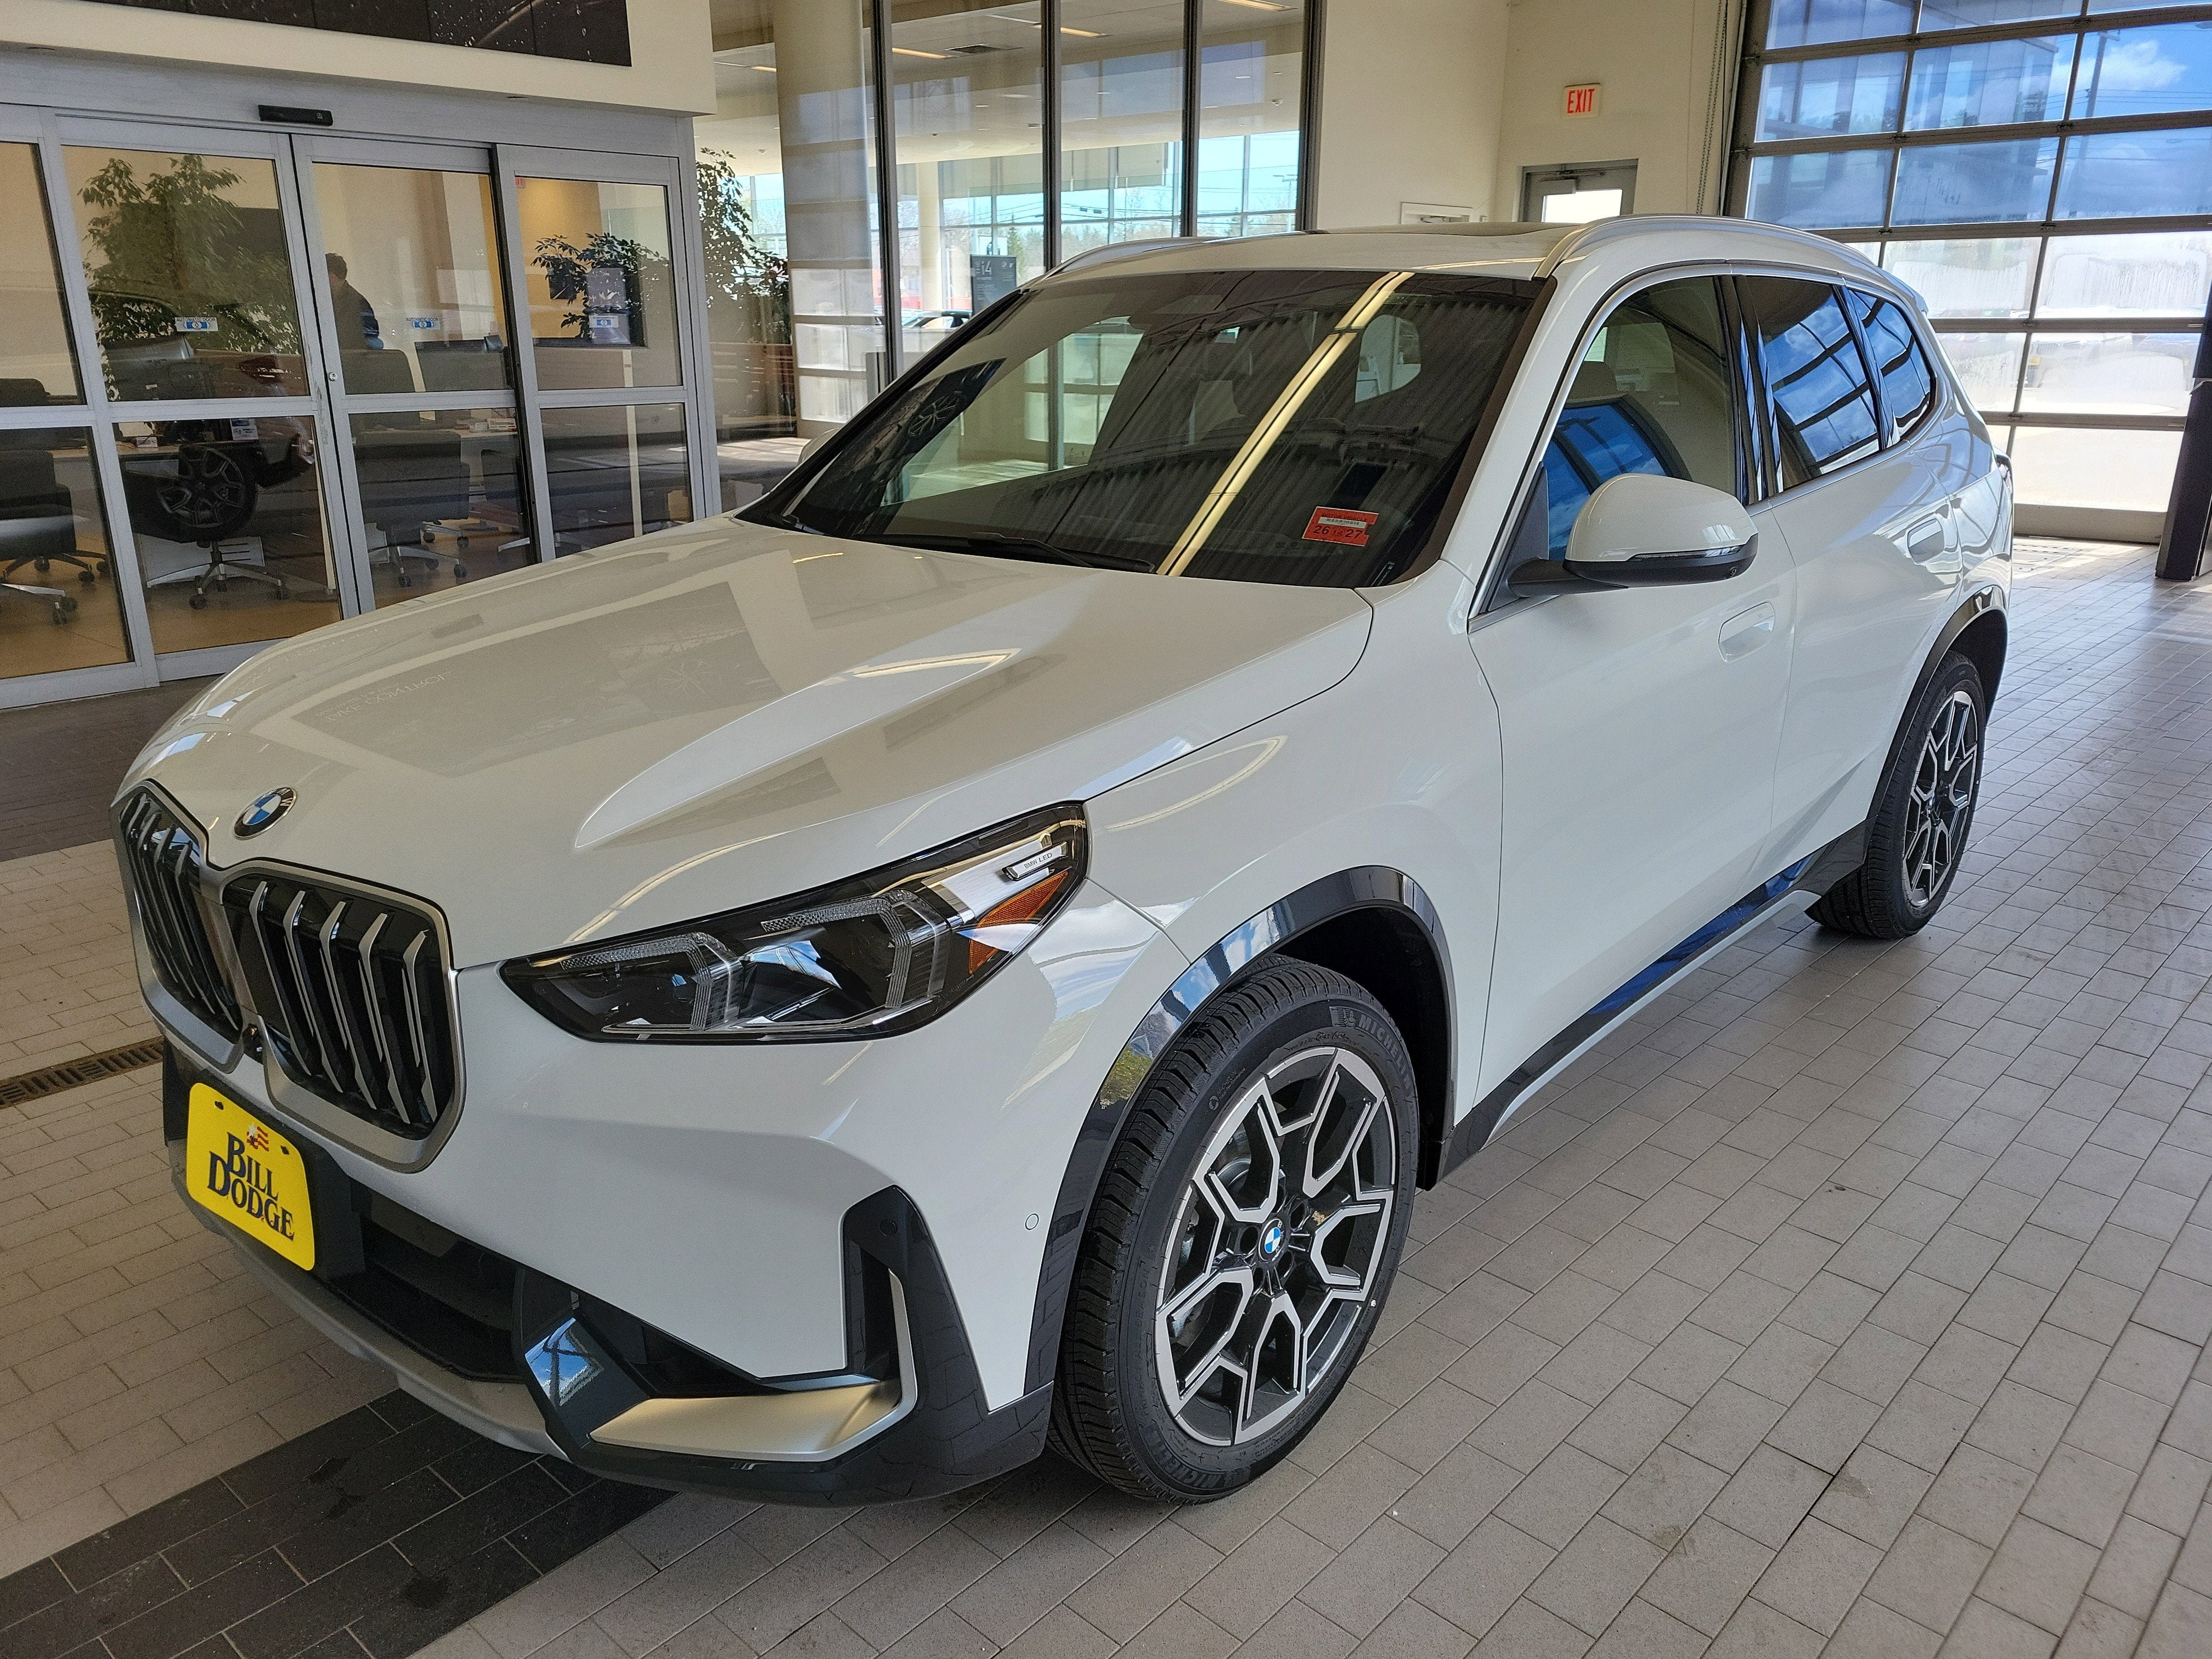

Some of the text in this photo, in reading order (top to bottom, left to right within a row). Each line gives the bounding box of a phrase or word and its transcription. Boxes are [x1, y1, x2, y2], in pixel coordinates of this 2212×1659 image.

[1567, 88, 1594, 113] EXIT
[1313, 525, 1330, 534] 26
[1345, 529, 1364, 538] 27
[1024, 853, 1053, 869] BMW LED
[1357, 1014, 1413, 1091] MICHELIN
[227, 1131, 279, 1201] BILL
[207, 1150, 295, 1242] DODGE
